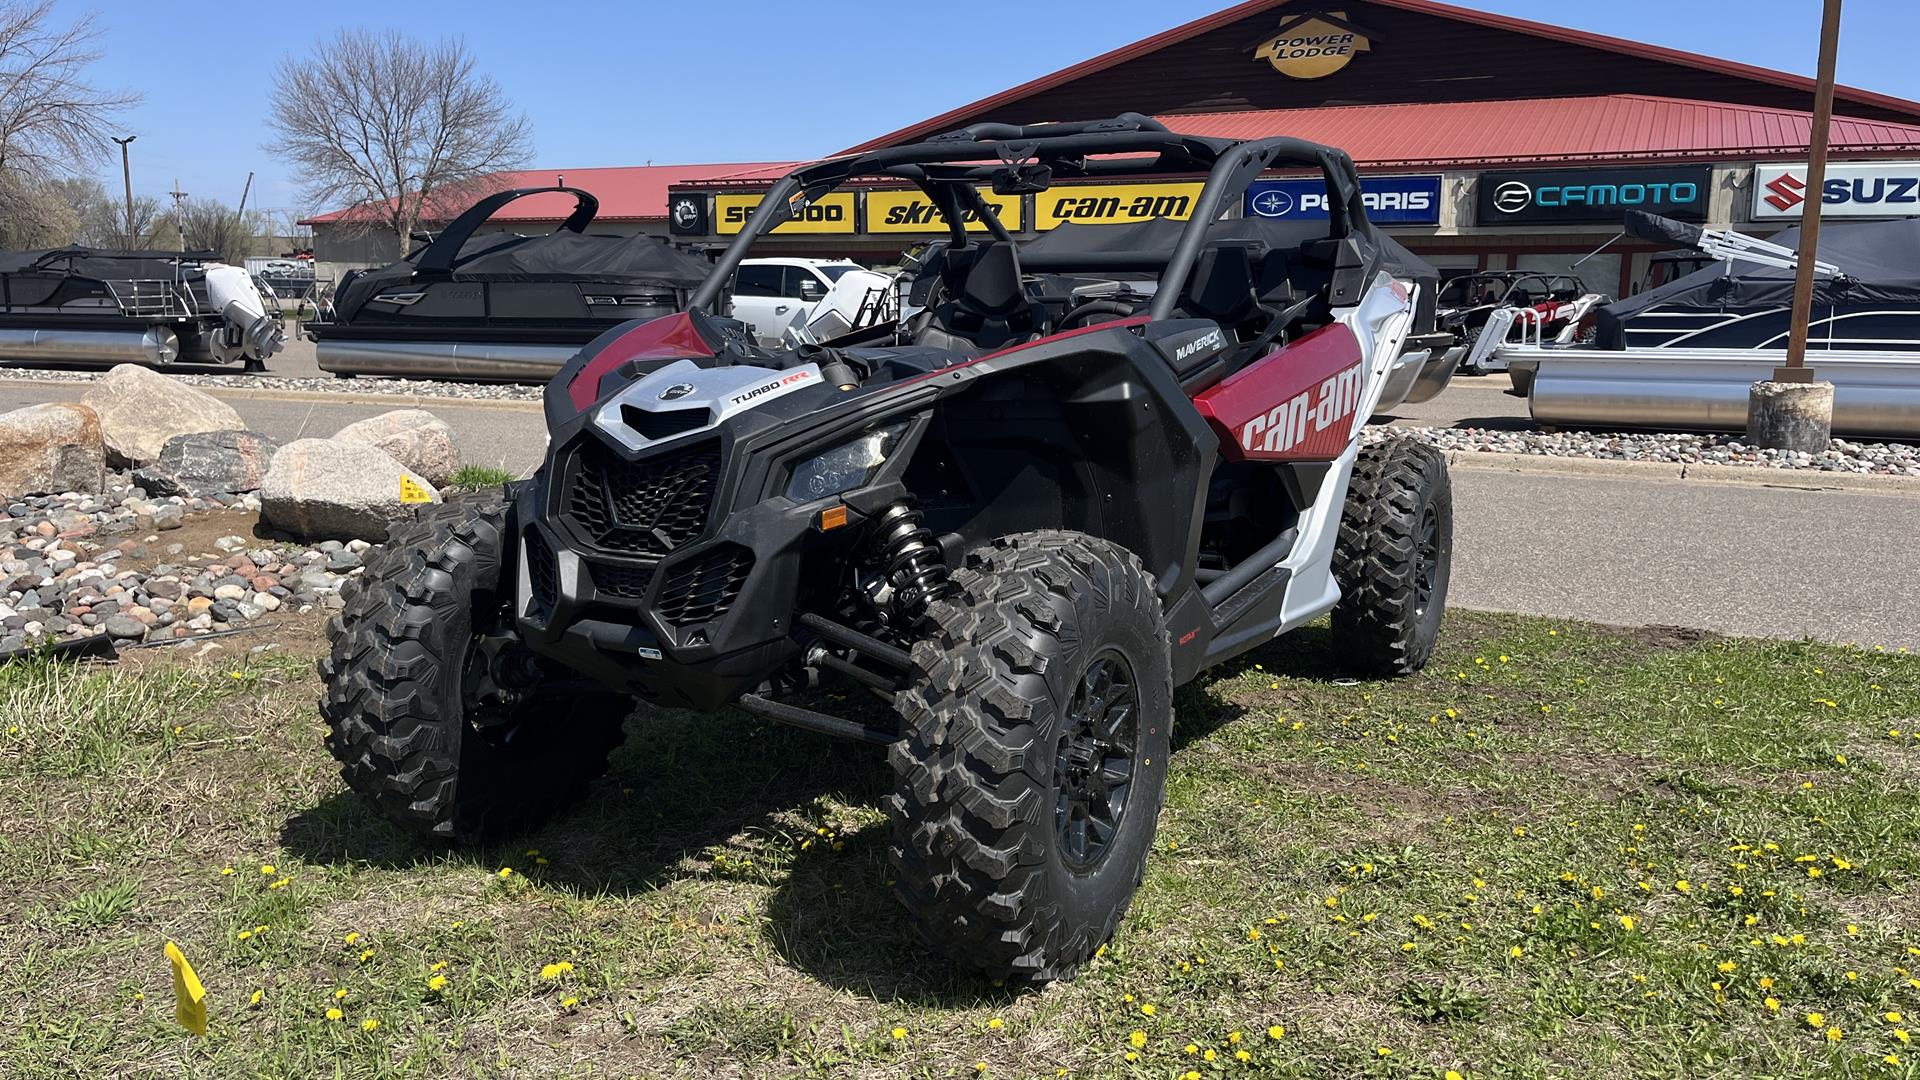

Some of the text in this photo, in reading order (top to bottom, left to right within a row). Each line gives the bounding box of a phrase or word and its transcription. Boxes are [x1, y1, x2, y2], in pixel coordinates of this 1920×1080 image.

[1272, 33, 1355, 51] POWER
[1276, 46, 1350, 60] LODGE
[1300, 192, 1430, 211] PARIS
[1536, 183, 1697, 206] CFMOTO
[1823, 178, 1920, 204] SUZ
[1052, 196, 1190, 218] can-am
[1176, 330, 1219, 360] MAVERICK
[731, 371, 810, 405] TURBO RR
[1242, 363, 1361, 452] can-am
